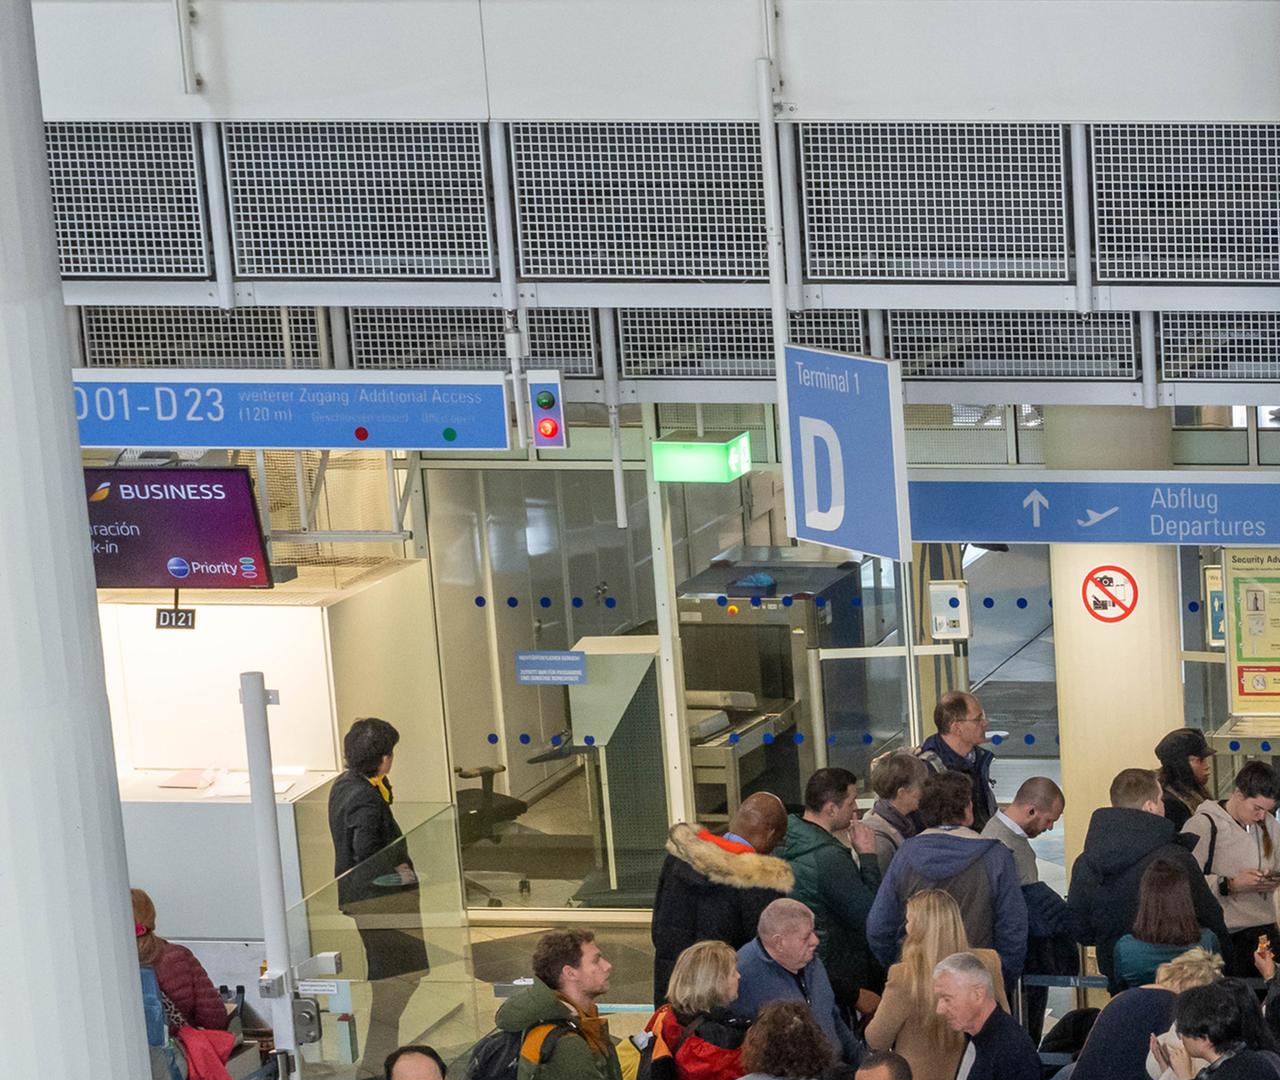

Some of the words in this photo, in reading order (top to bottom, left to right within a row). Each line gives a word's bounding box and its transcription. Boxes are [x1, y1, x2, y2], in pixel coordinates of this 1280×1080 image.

[795, 361, 849, 394] Terminal
[854, 373, 859, 394] 1
[800, 417, 845, 531] D
[120, 485, 225, 499] BUSINESS
[1151, 488, 1217, 513] Abflug
[1151, 515, 1265, 541] Departures
[192, 562, 237, 575] Priority
[1232, 555, 1264, 565] Security
[160, 612, 192, 626] D121
